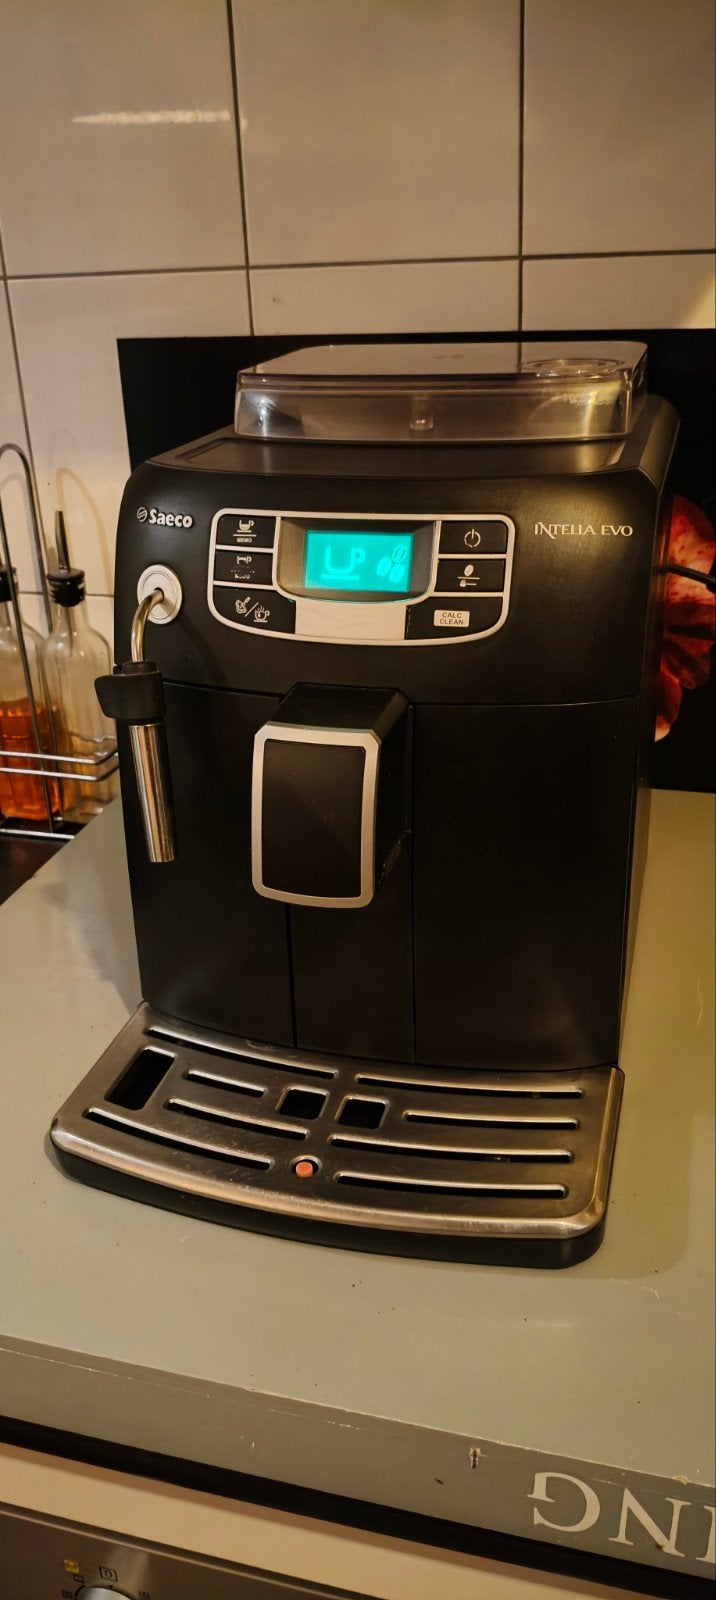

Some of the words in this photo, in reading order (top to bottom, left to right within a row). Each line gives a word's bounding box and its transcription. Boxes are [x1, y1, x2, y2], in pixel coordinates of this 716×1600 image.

[148, 508, 194, 529] Saeco
[534, 521, 597, 539] INTELIA
[601, 524, 634, 537] EVO
